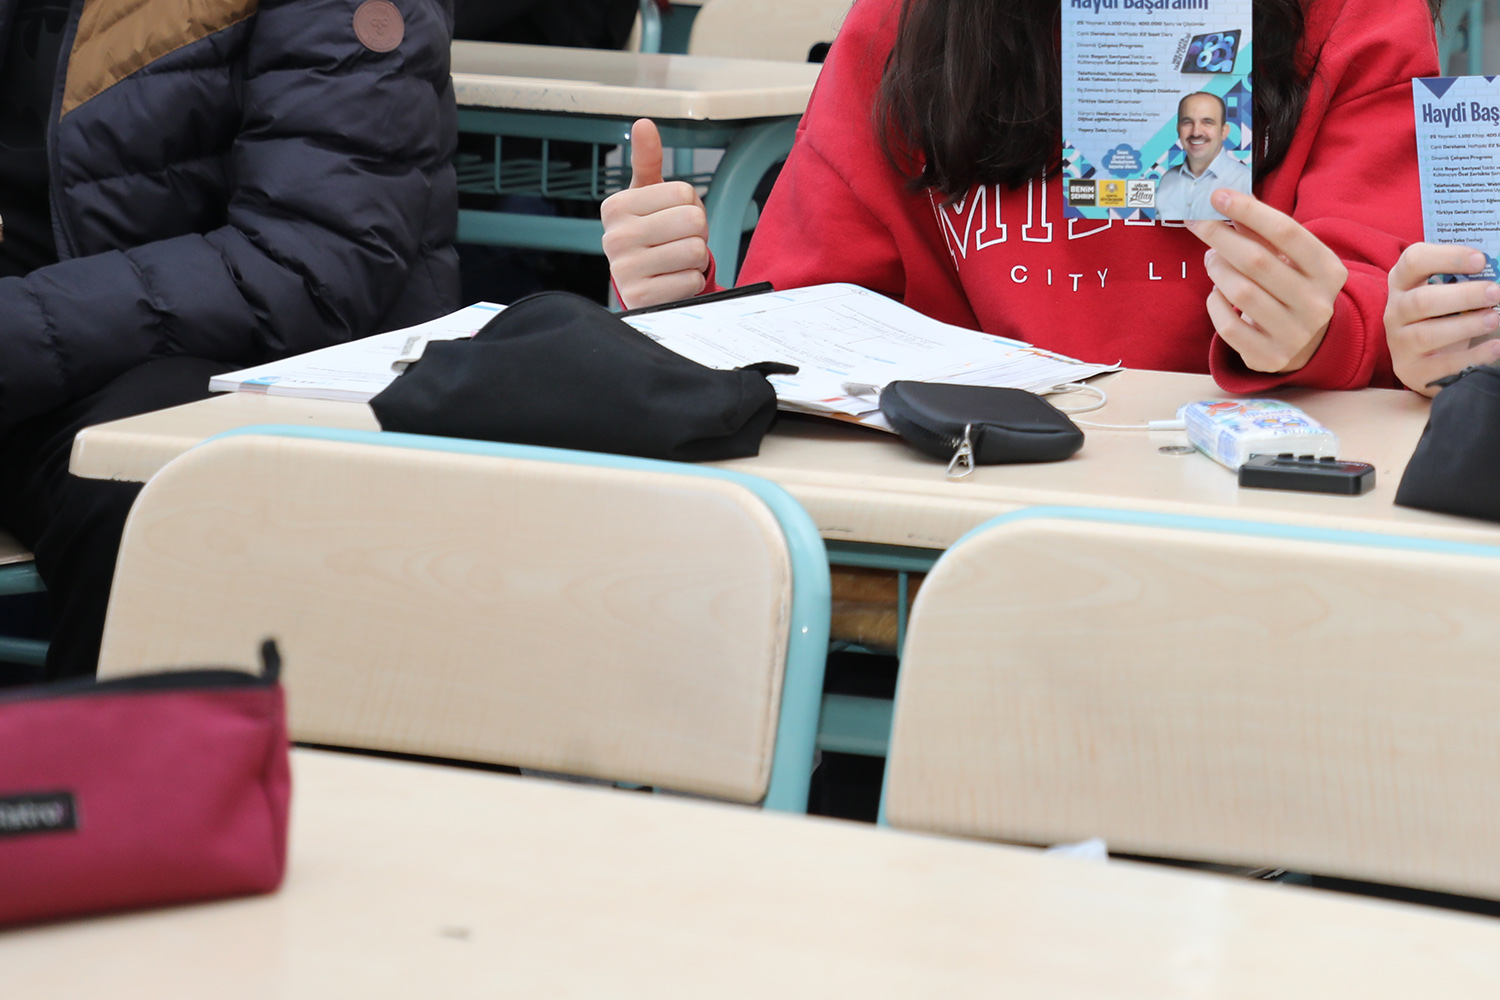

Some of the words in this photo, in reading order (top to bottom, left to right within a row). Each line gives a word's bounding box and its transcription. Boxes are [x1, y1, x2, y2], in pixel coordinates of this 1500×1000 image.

[1422, 103, 1466, 127] Haydi
[1010, 264, 1109, 291] CITY
[1149, 261, 1187, 280] LI
